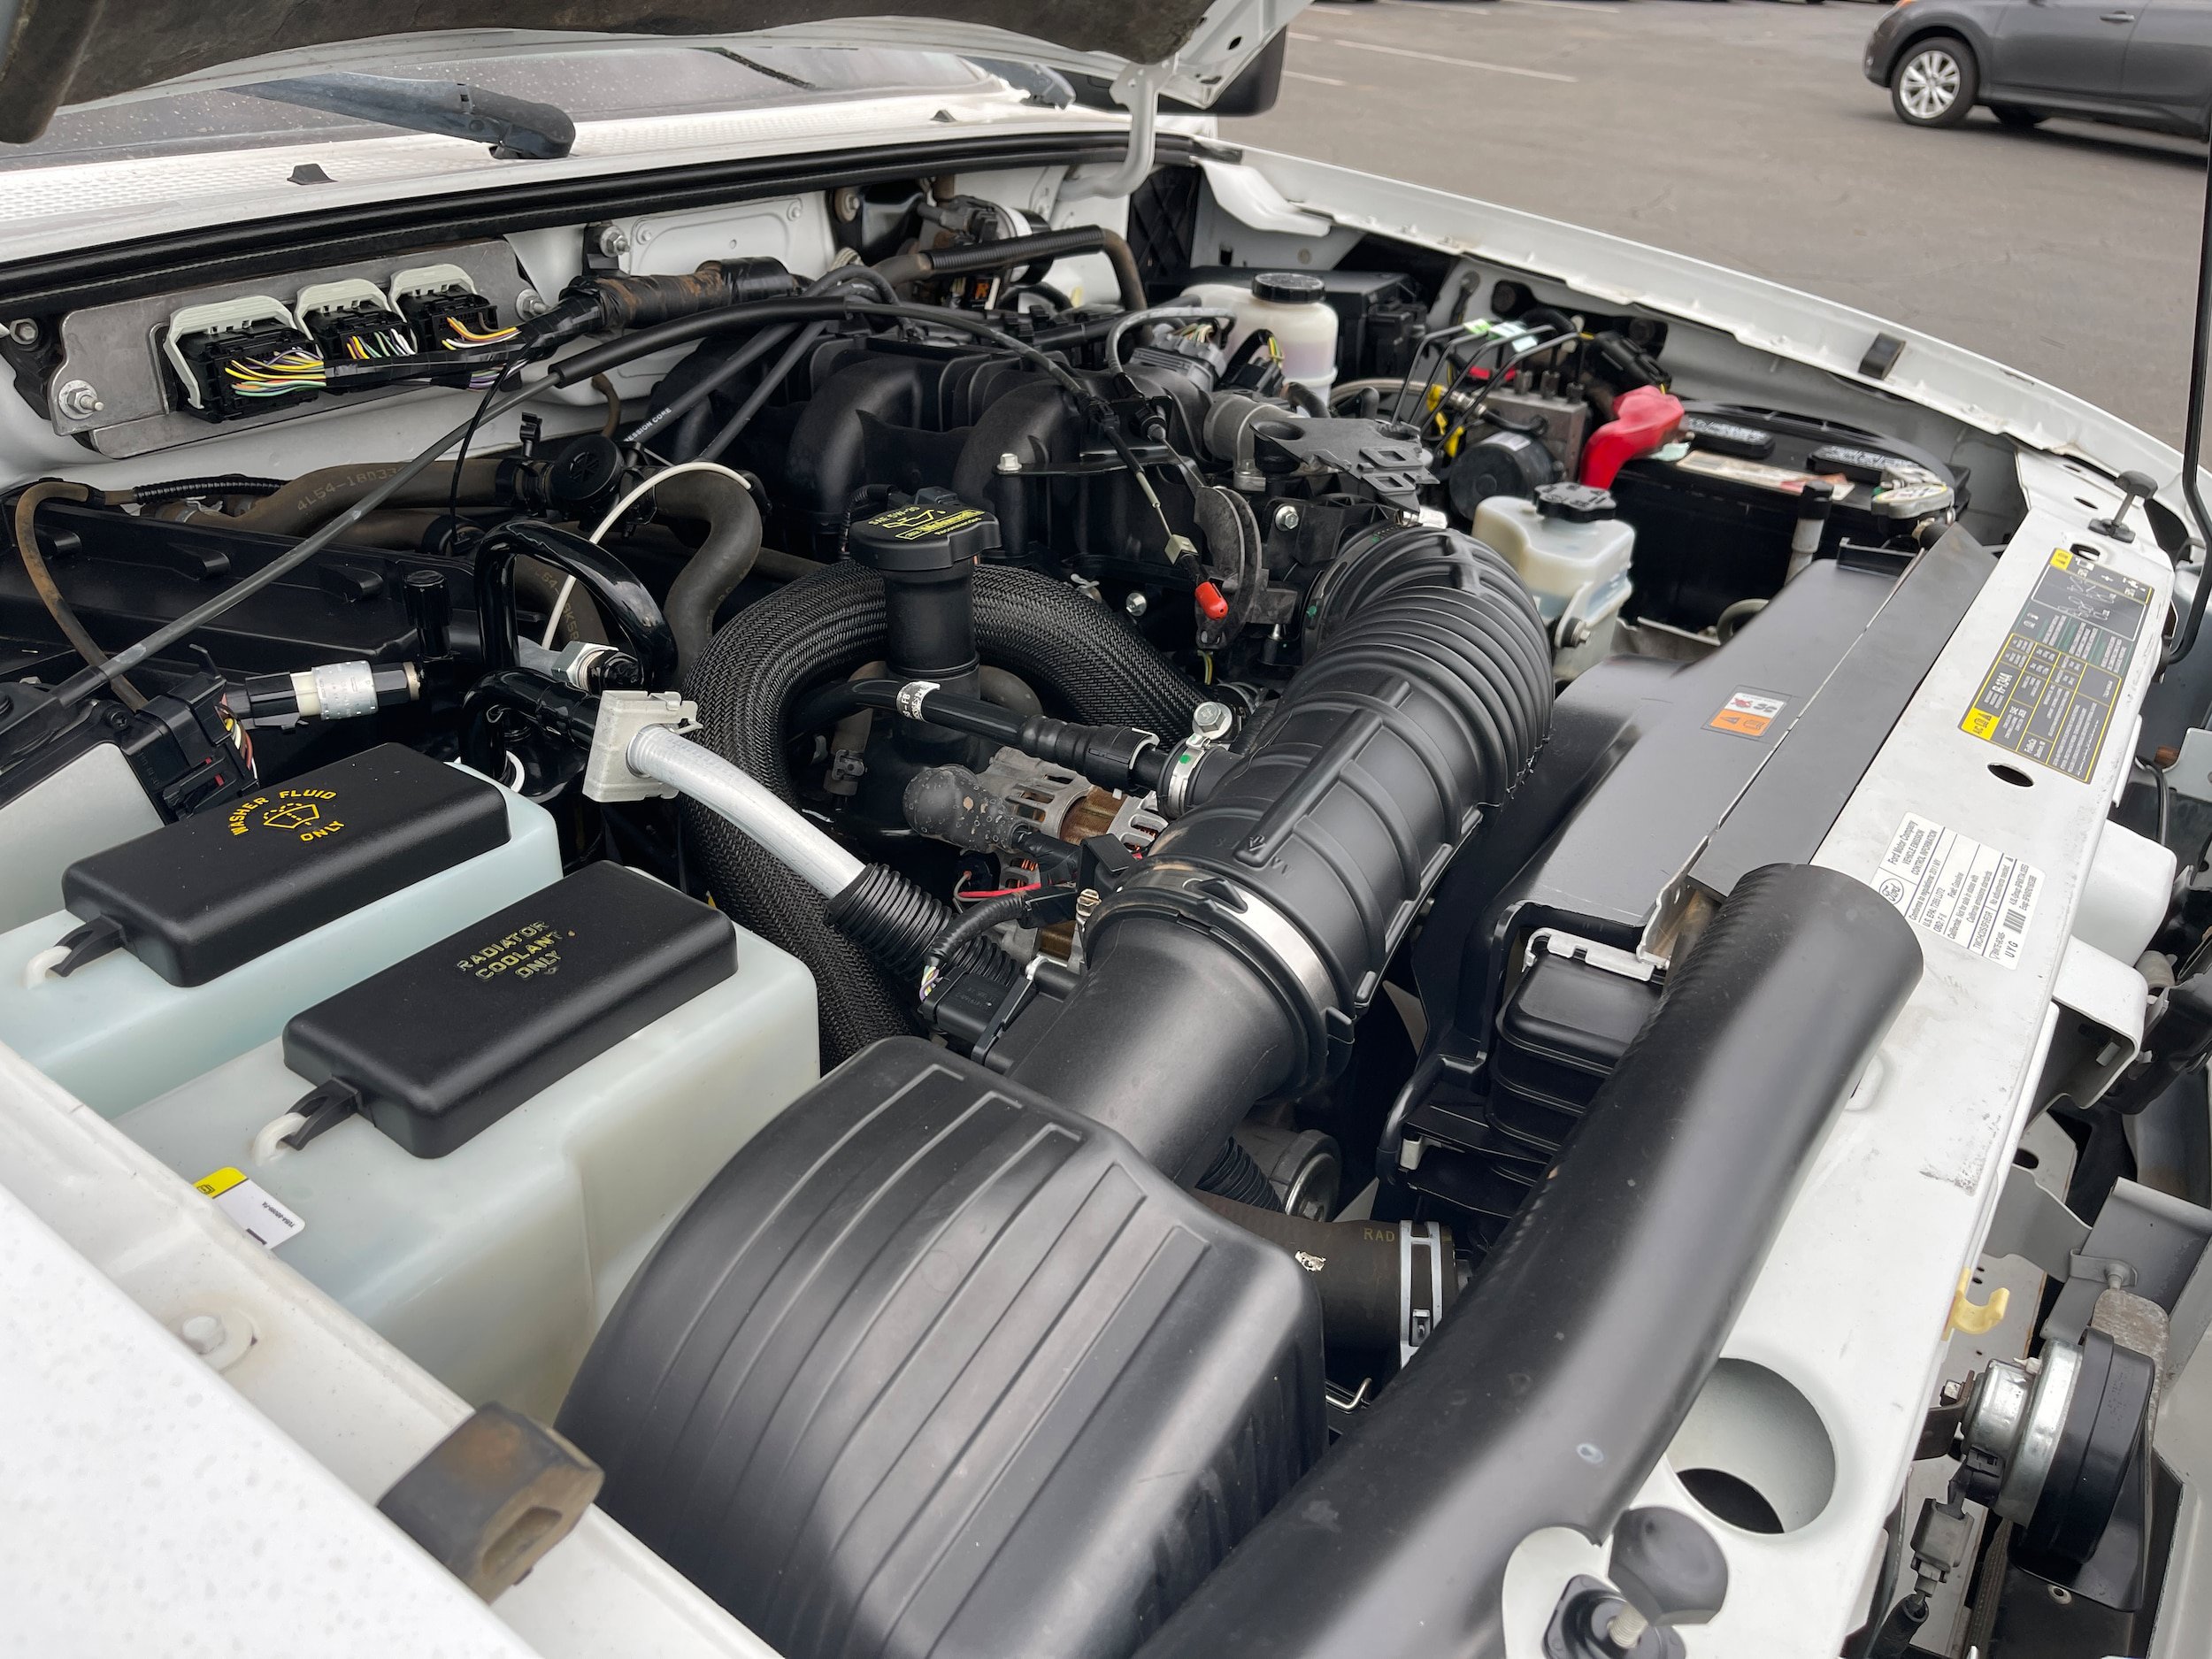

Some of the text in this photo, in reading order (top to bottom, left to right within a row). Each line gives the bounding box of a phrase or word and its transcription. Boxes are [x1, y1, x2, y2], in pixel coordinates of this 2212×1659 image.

[652, 407, 672, 423] CORE
[228, 788, 337, 836] WASHER FLUID
[300, 820, 345, 841] ONLY
[1887, 820, 1919, 865] Ford Motor Company
[1902, 829, 1925, 865] VEHICLE EMISSION
[1911, 830, 1938, 876] CONTROL INFORMATION
[1881, 883, 1901, 902] Ford
[1909, 901, 1924, 921] Conforms
[457, 921, 549, 972] RADIATOR
[475, 931, 563, 979] COOLANT
[515, 950, 561, 979] ONLY
[1363, 1228, 1395, 1242] RAD
